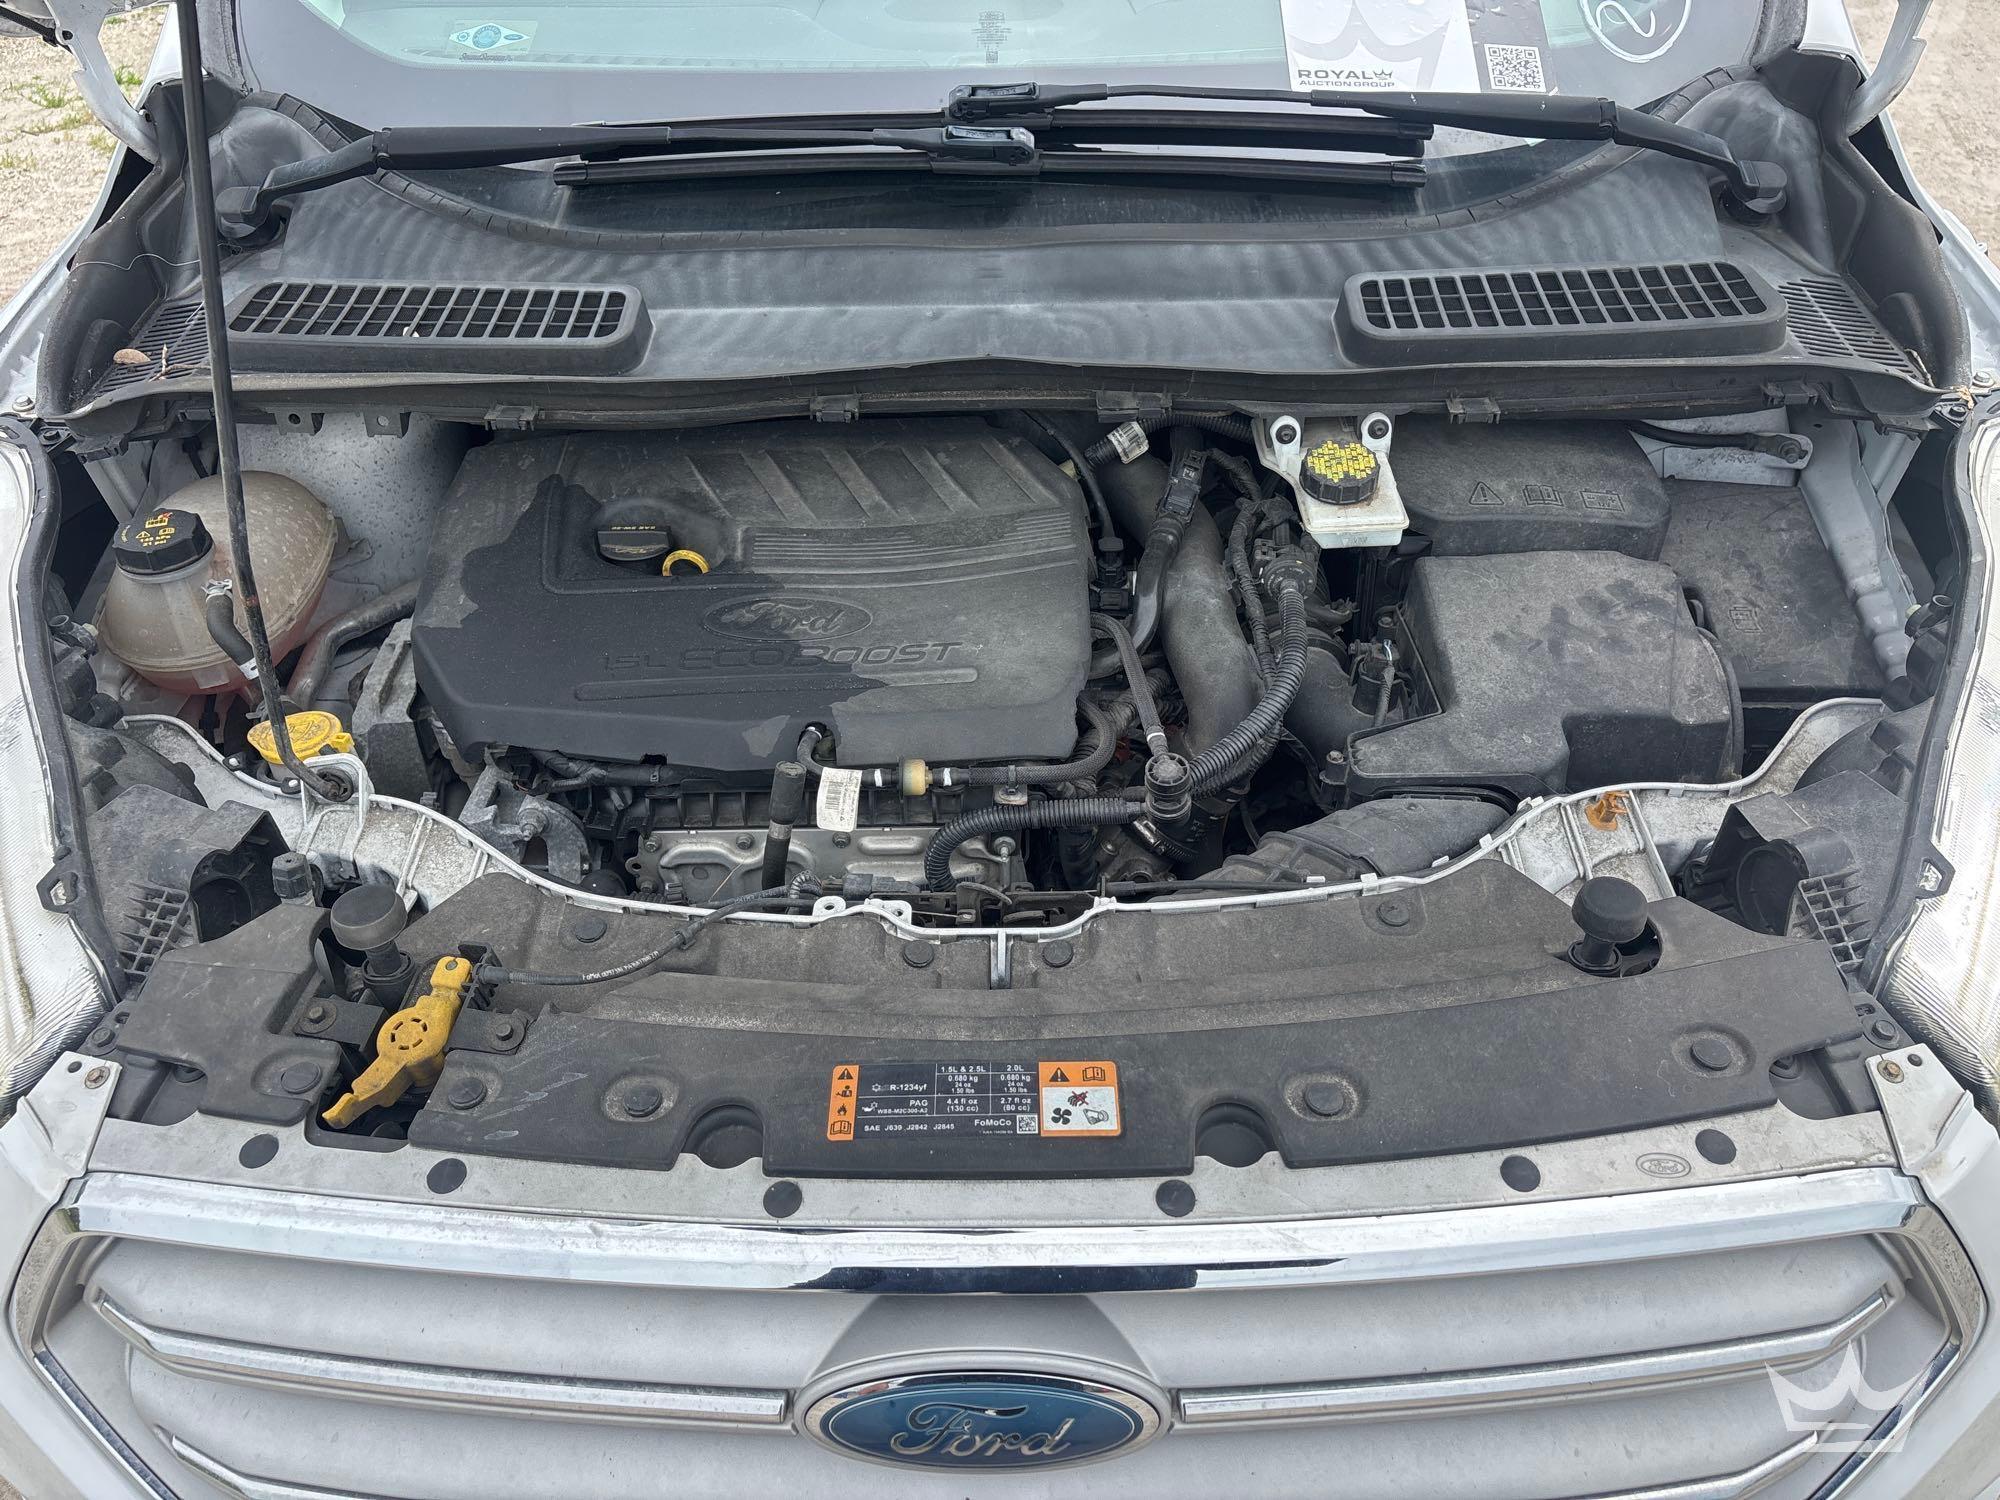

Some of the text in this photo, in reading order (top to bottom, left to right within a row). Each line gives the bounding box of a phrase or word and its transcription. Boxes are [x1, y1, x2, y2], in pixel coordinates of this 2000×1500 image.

[1298, 69, 1374, 80] ROYAL
[719, 601, 846, 635] Ford
[679, 641, 964, 672] ECOBOOST
[941, 1065, 958, 1073] 1.5L
[968, 1065, 986, 1073] 2.5L
[1006, 1064, 1024, 1072] 2.0L
[948, 1074, 979, 1083] 0.680 kg
[1021, 1074, 1031, 1082] kg
[889, 1083, 928, 1092] R-1234yf
[909, 1099, 928, 1107] PAG
[1003, 1104, 1030, 1112] (80 cc)
[864, 1124, 880, 1132] SAE
[884, 1124, 903, 1132] J639
[933, 1123, 955, 1131] J2845
[974, 1119, 1012, 1127] FoMoCo
[890, 1402, 1077, 1457] Ford
